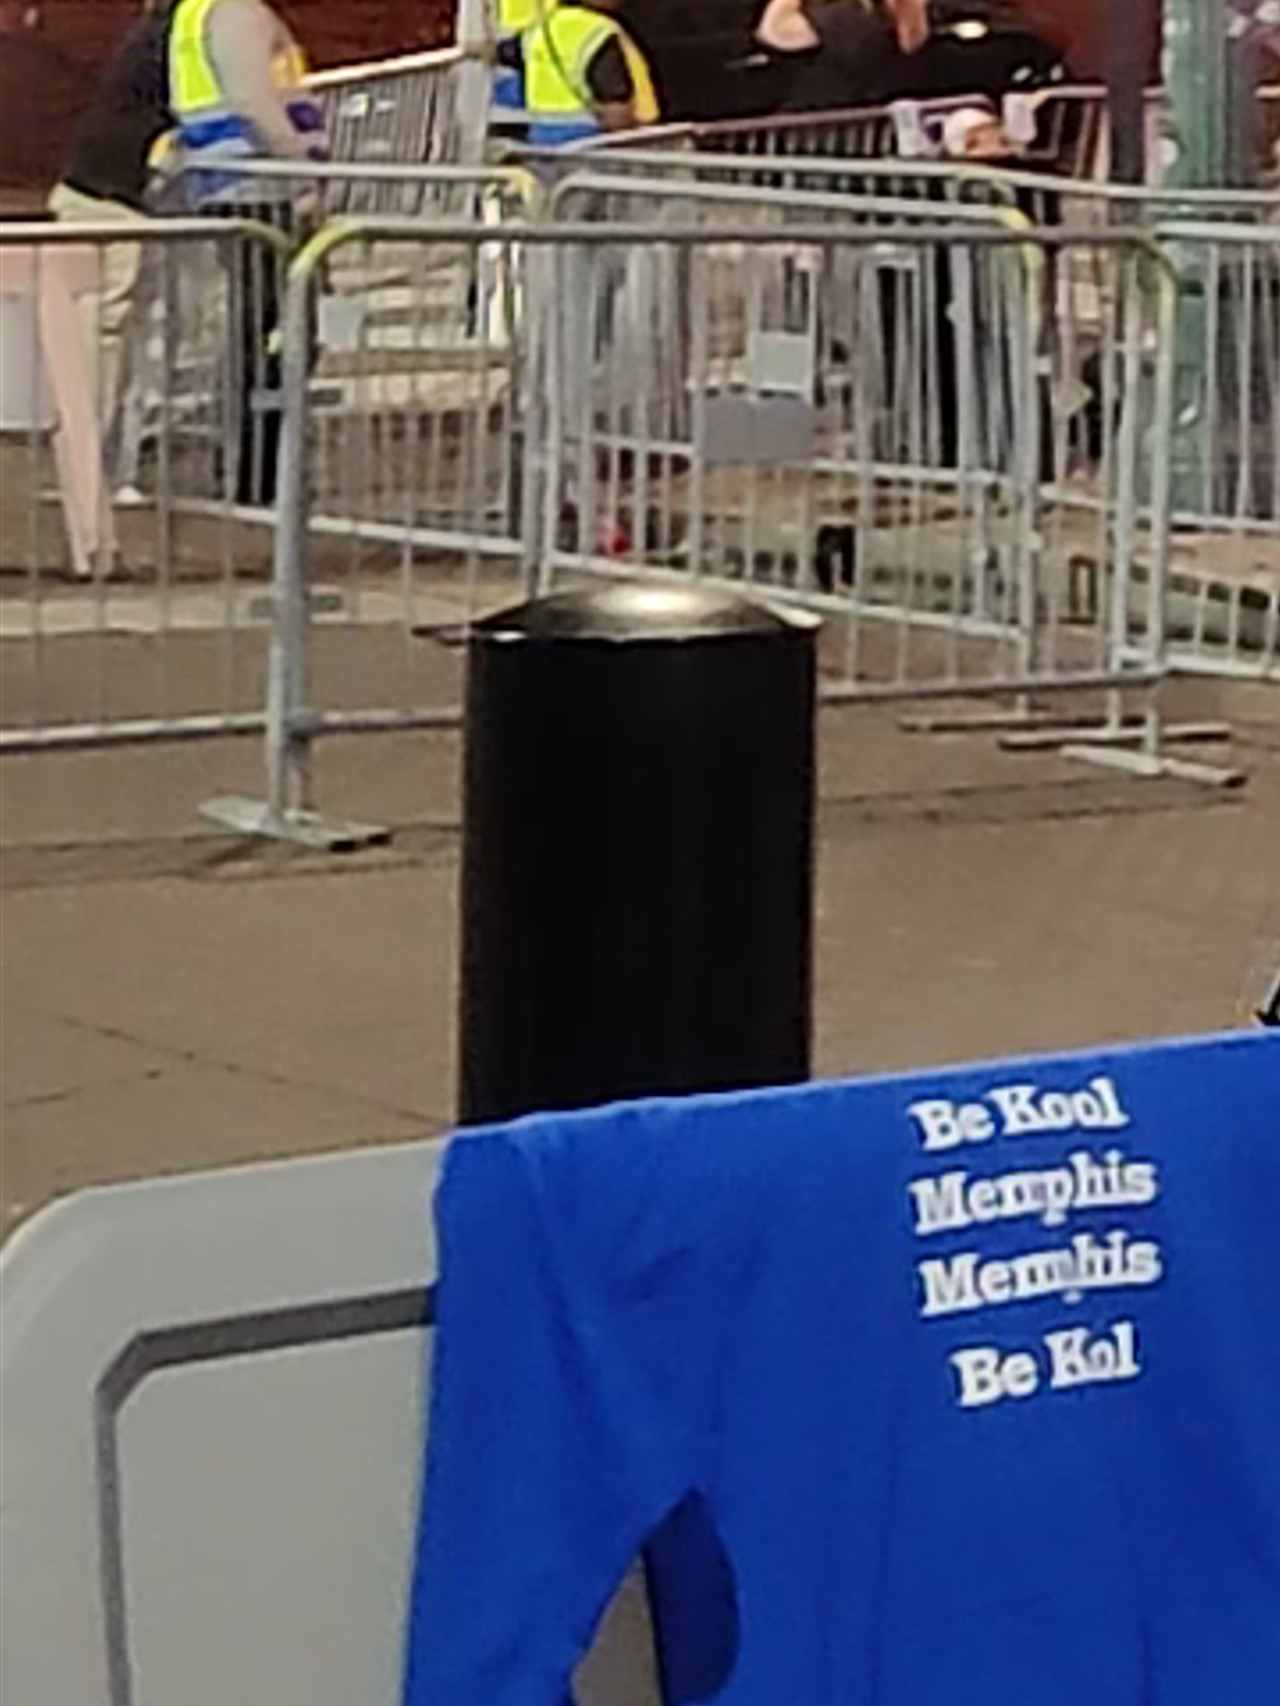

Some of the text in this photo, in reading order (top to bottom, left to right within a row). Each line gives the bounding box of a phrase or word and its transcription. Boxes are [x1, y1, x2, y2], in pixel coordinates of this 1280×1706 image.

[907, 1077, 1130, 1151] Be Kool
[908, 1150, 1158, 1235] Memphis
[918, 1230, 1163, 1316] Memphis
[950, 1321, 1140, 1407] Be Kol
